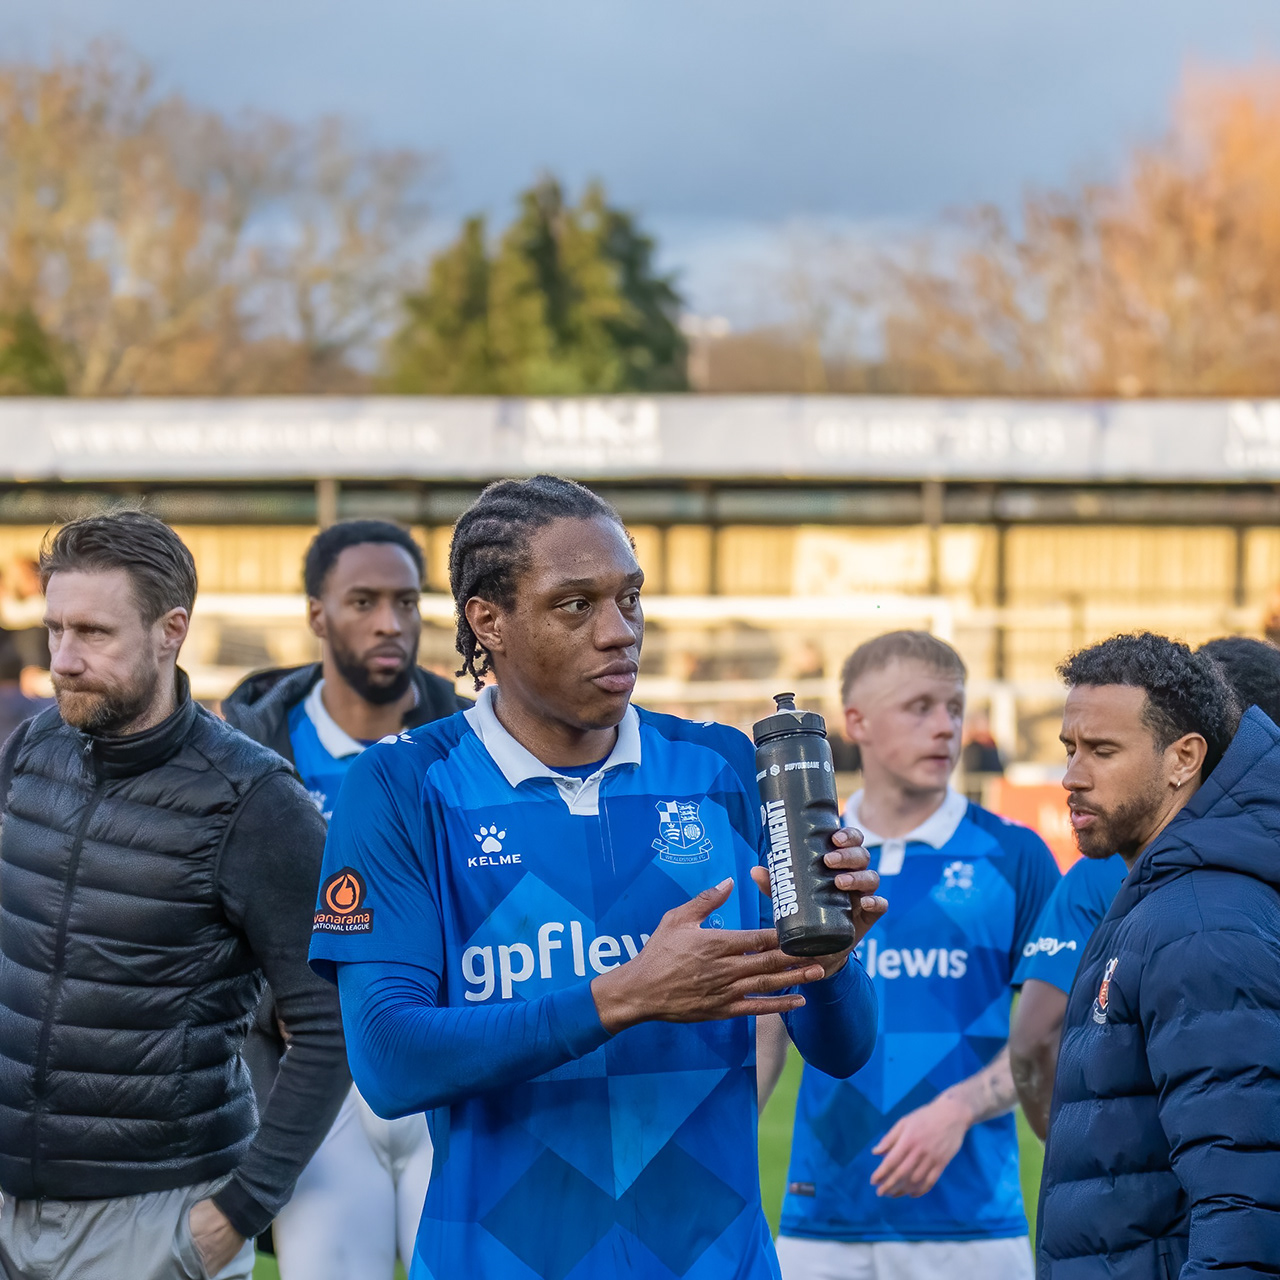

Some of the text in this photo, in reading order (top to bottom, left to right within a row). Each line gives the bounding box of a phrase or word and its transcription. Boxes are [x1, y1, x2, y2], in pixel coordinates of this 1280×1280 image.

[467, 853, 522, 868] KELME
[766, 799, 799, 919] SUPPLEMENT
[345, 923, 370, 931] LEAGUE
